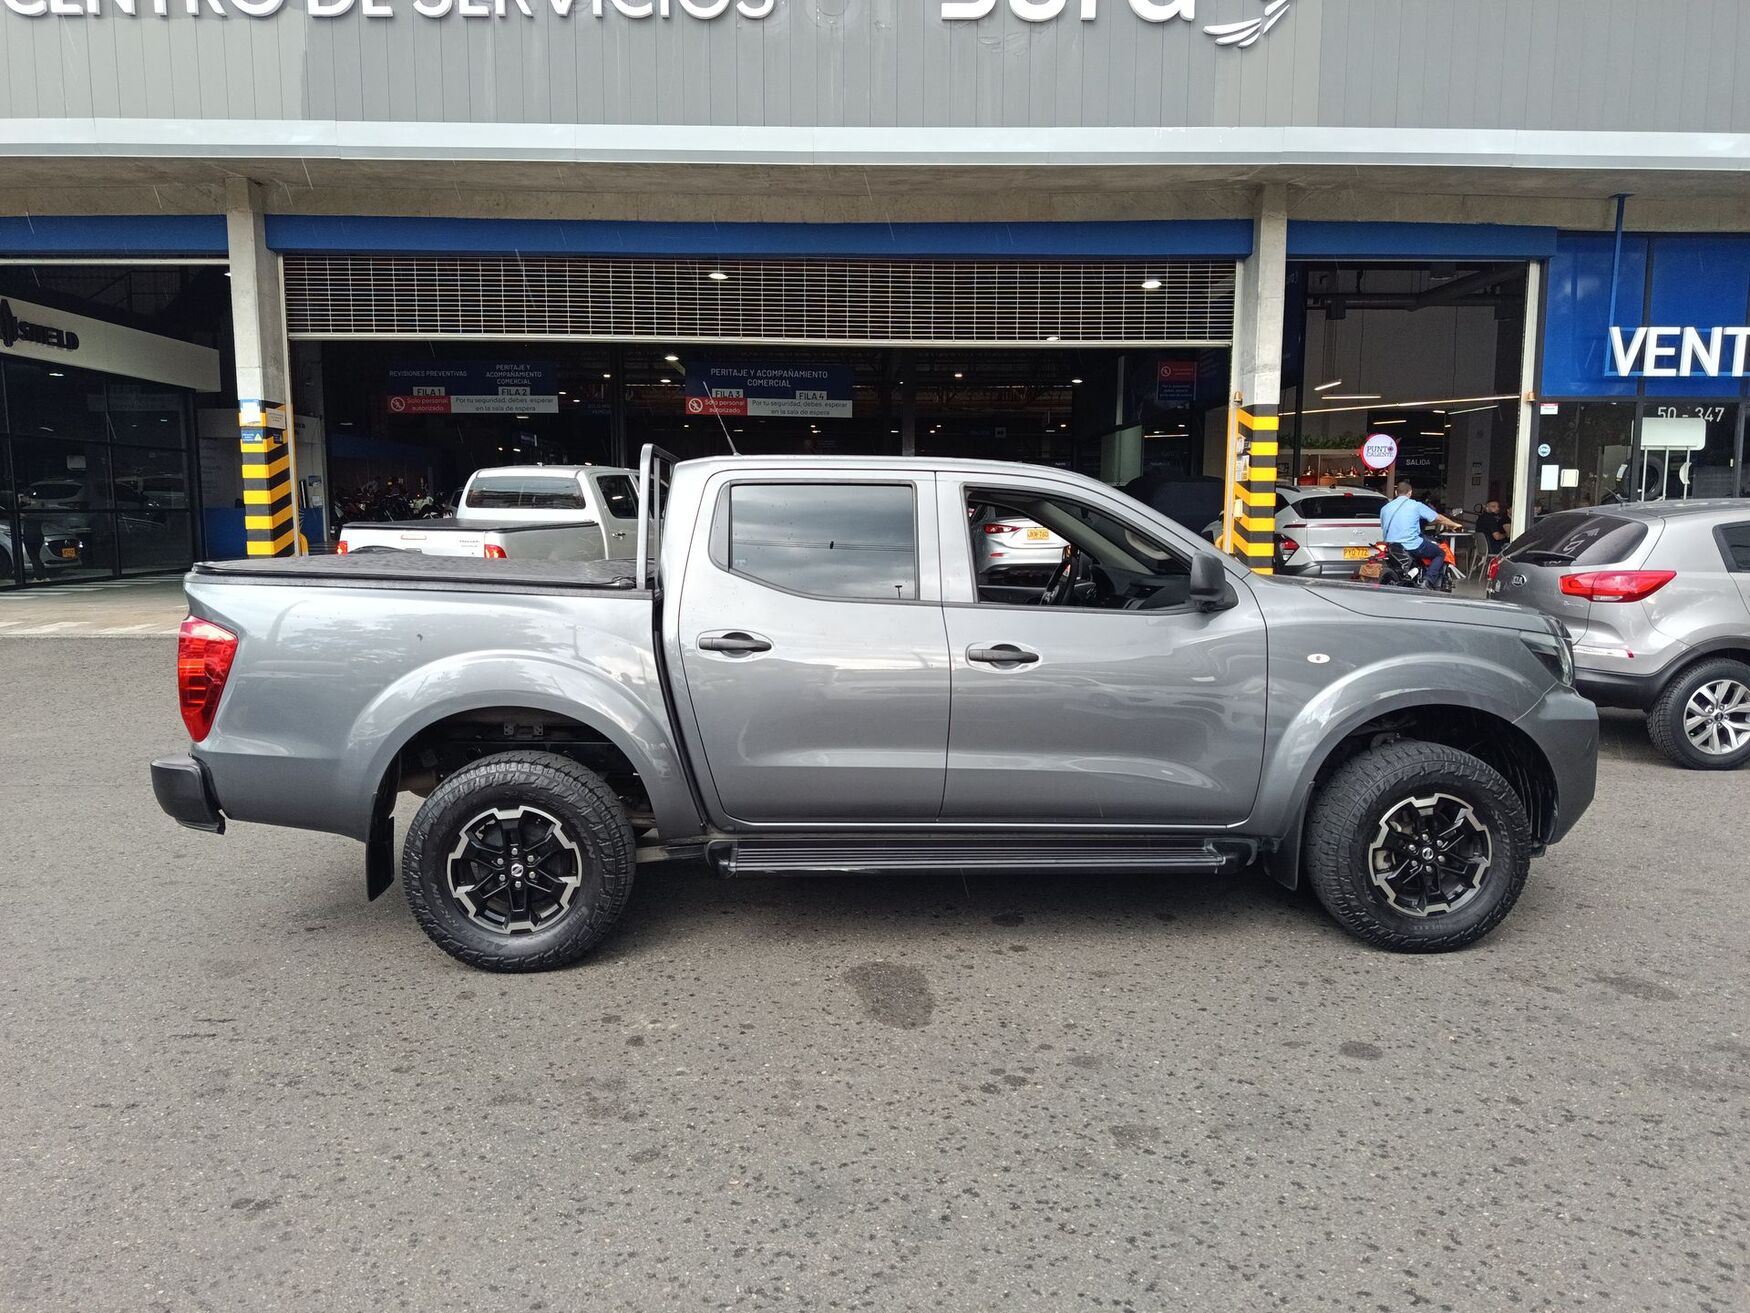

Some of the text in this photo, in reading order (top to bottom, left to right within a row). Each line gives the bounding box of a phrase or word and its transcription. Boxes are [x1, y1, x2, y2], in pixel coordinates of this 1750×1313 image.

[711, 368, 828, 379] PERITAJE Y ACOMPAÑAMIENTO
[747, 379, 791, 388] COMERCIAL
[417, 388, 436, 396] FILA
[502, 388, 520, 396] FILA
[715, 390, 734, 398] FILA
[799, 392, 817, 400] FILA
[1694, 407, 1725, 422] 347
[1405, 458, 1431, 467] SALIDA
